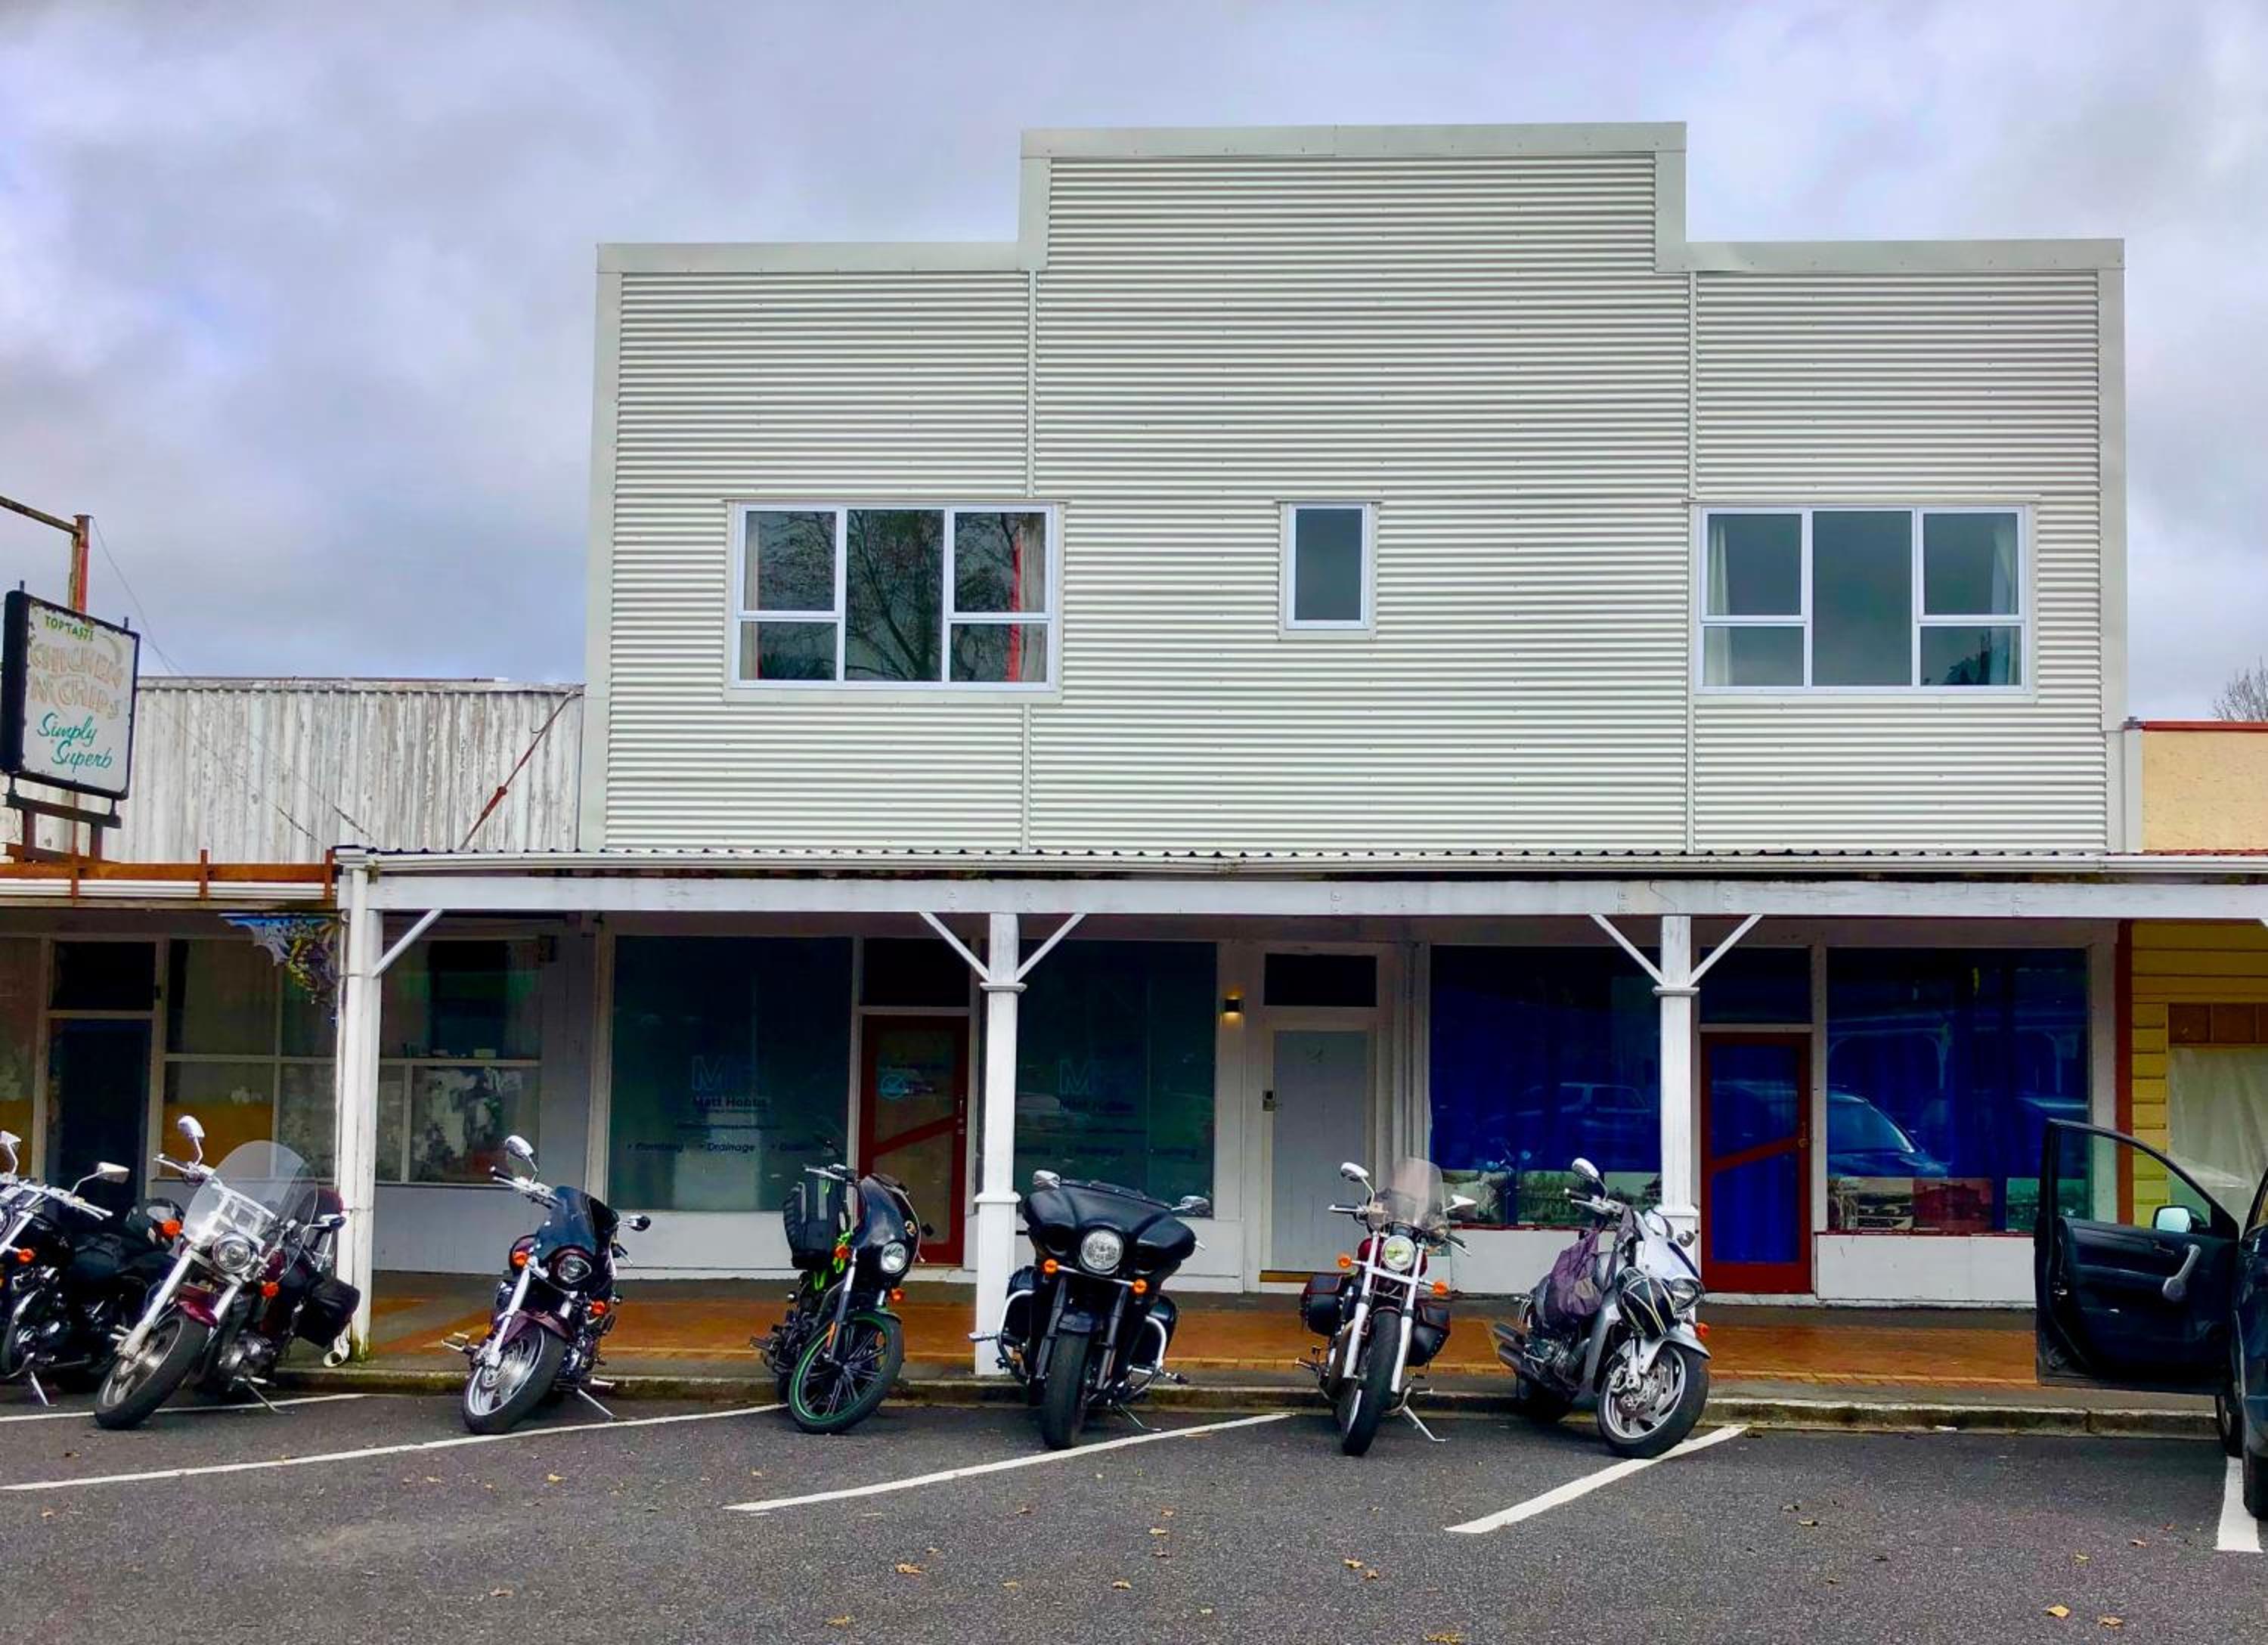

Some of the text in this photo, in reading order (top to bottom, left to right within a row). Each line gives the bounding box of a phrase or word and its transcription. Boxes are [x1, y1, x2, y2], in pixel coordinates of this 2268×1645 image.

[36, 711, 98, 748] Simply
[51, 740, 113, 773] Superb
[707, 1142, 755, 1153] Drainage
